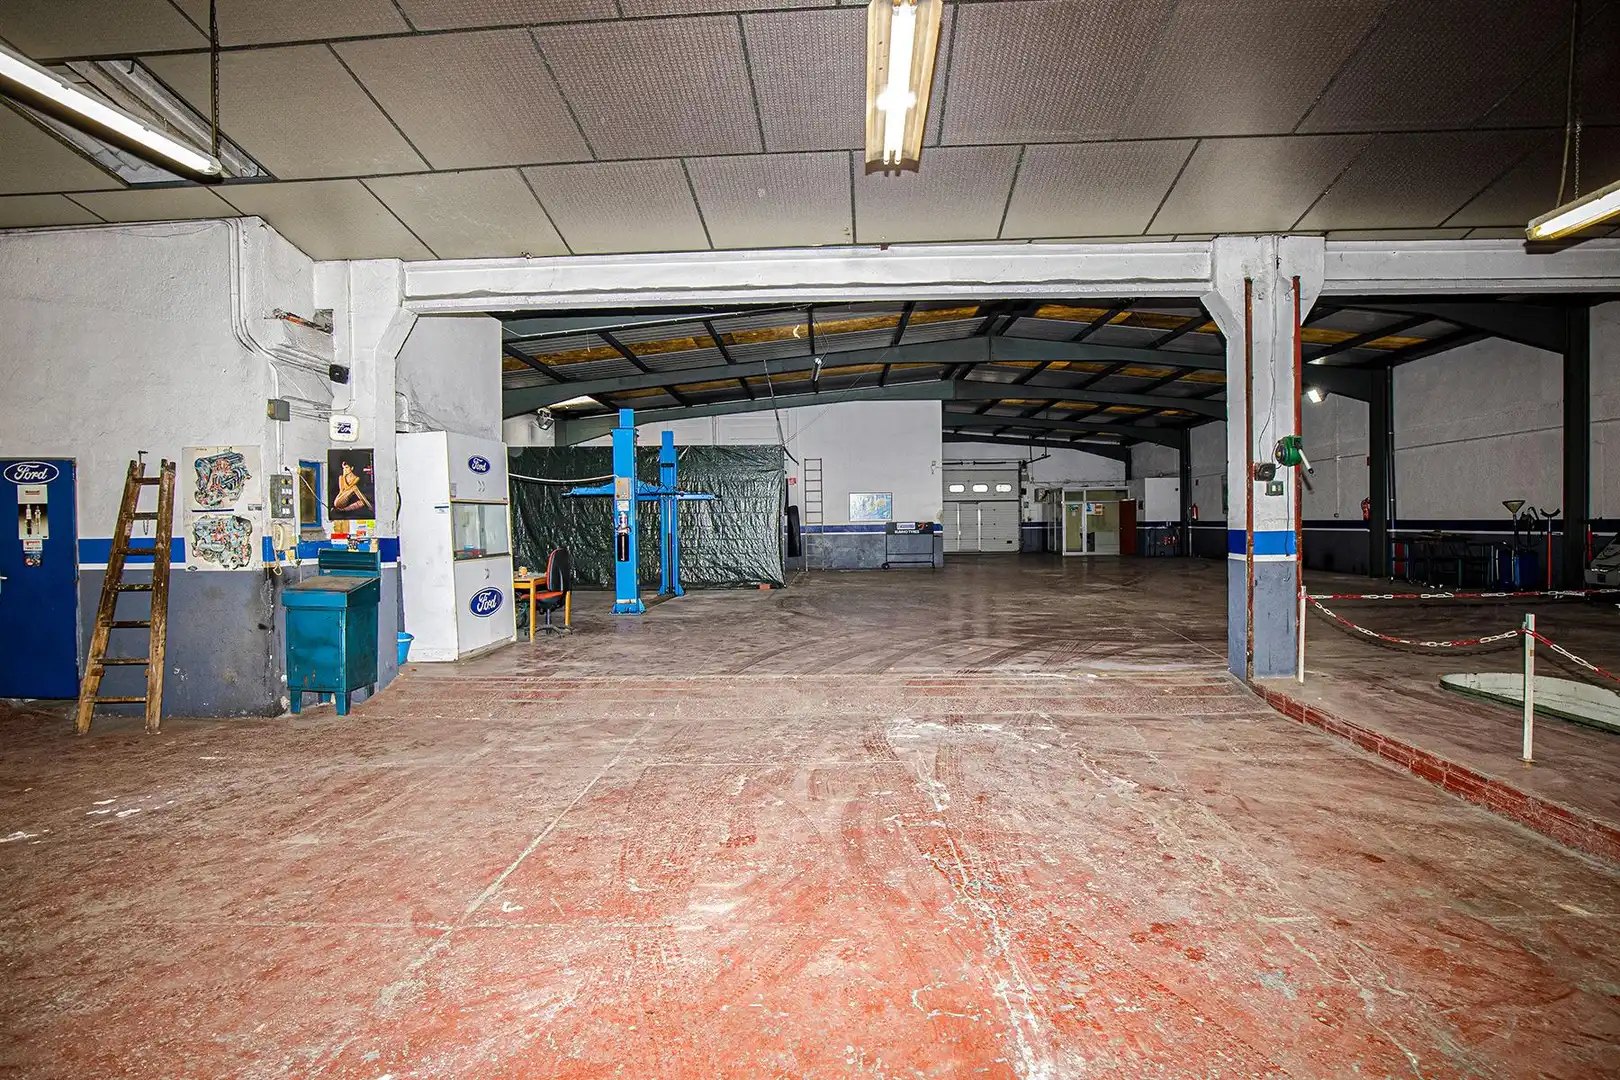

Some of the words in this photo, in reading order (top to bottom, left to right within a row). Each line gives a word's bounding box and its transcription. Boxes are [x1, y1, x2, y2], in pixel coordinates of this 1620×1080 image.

[14, 464, 48, 480] Ford
[472, 457, 487, 471] Ford
[477, 592, 497, 612] Ford
